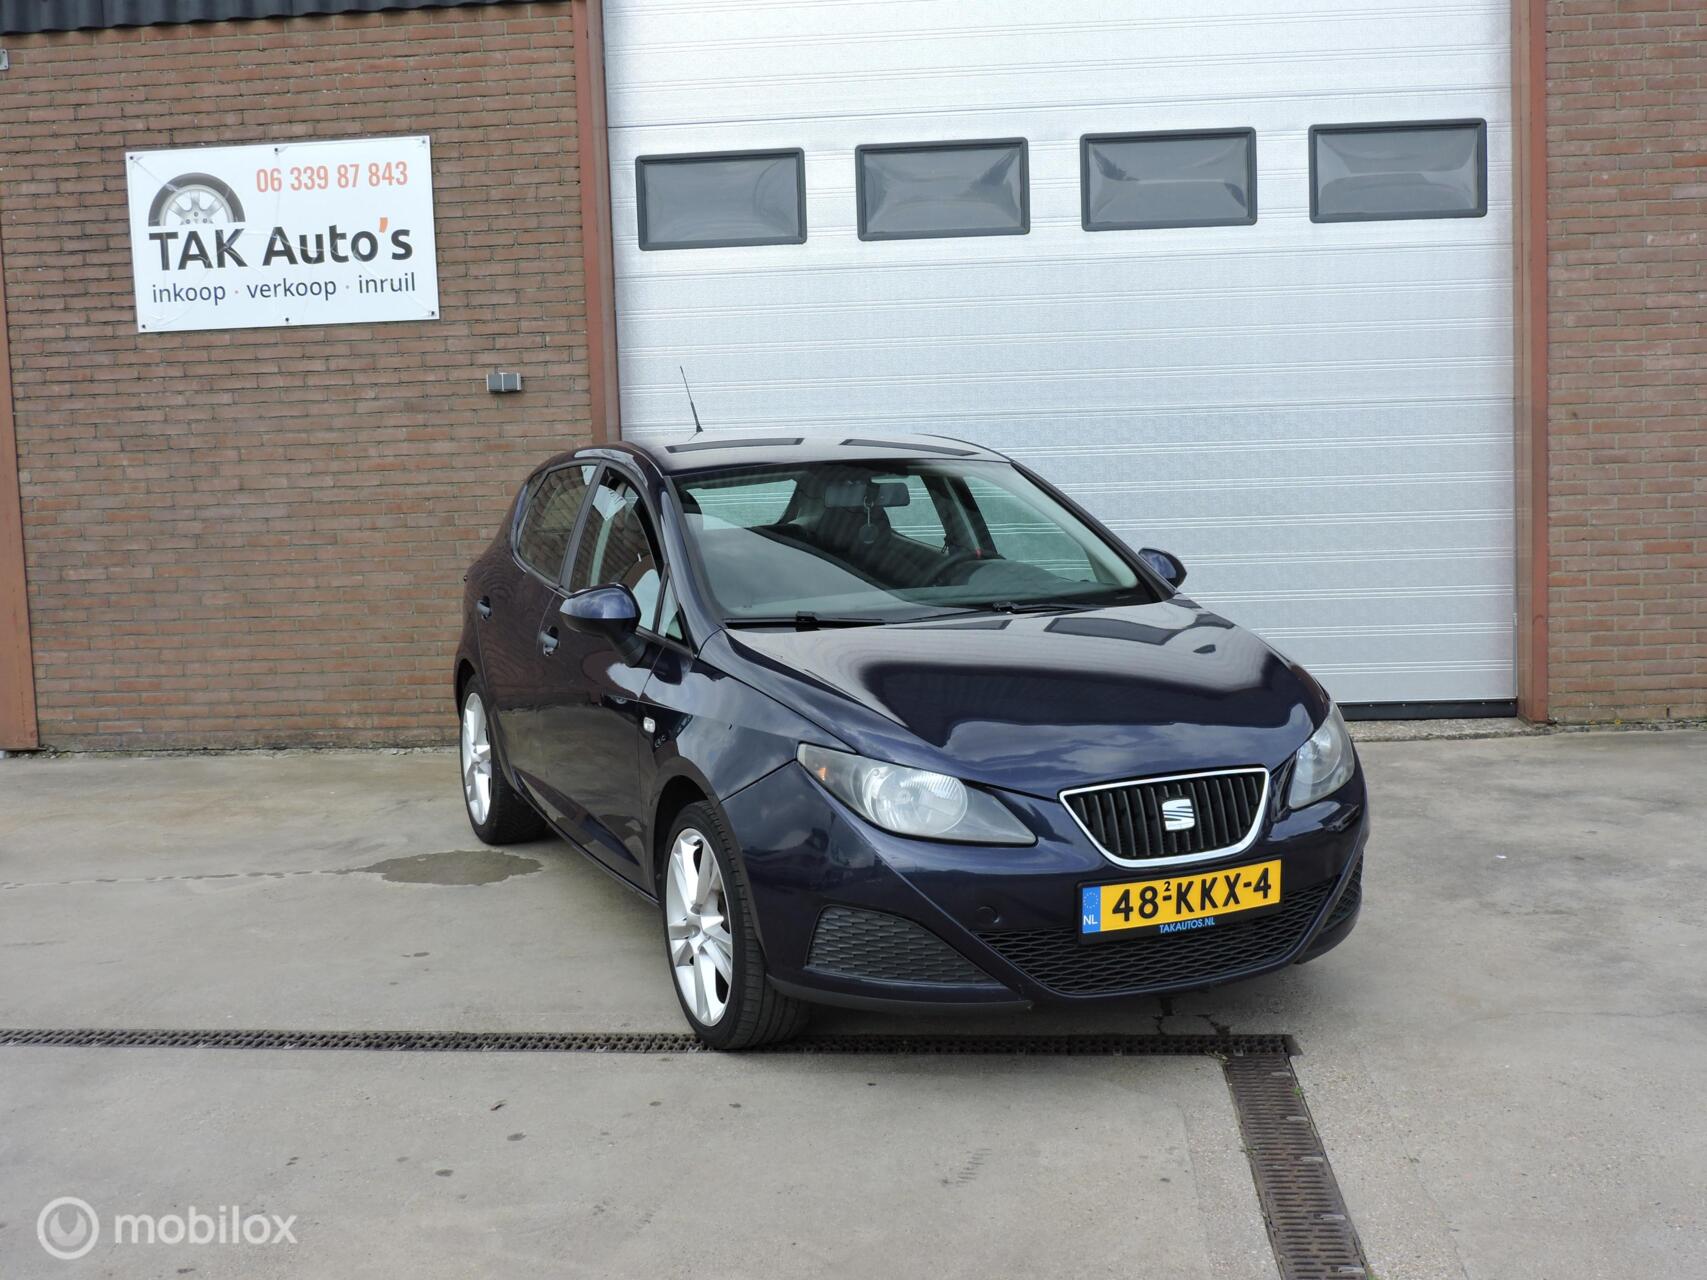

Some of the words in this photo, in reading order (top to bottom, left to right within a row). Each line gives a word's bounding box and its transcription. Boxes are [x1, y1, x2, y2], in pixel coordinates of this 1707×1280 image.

[256, 168, 282, 193] 06
[290, 165, 329, 191] 339
[337, 164, 360, 188] 87
[367, 161, 408, 187] 843
[148, 228, 248, 271] TAK
[262, 217, 413, 266] Auto's
[152, 283, 226, 306] inkoop
[246, 276, 337, 301] verkoop
[358, 272, 416, 294] inruil
[1083, 914, 1098, 925] NL
[1159, 917, 1216, 933] TAKAUTOS.NL
